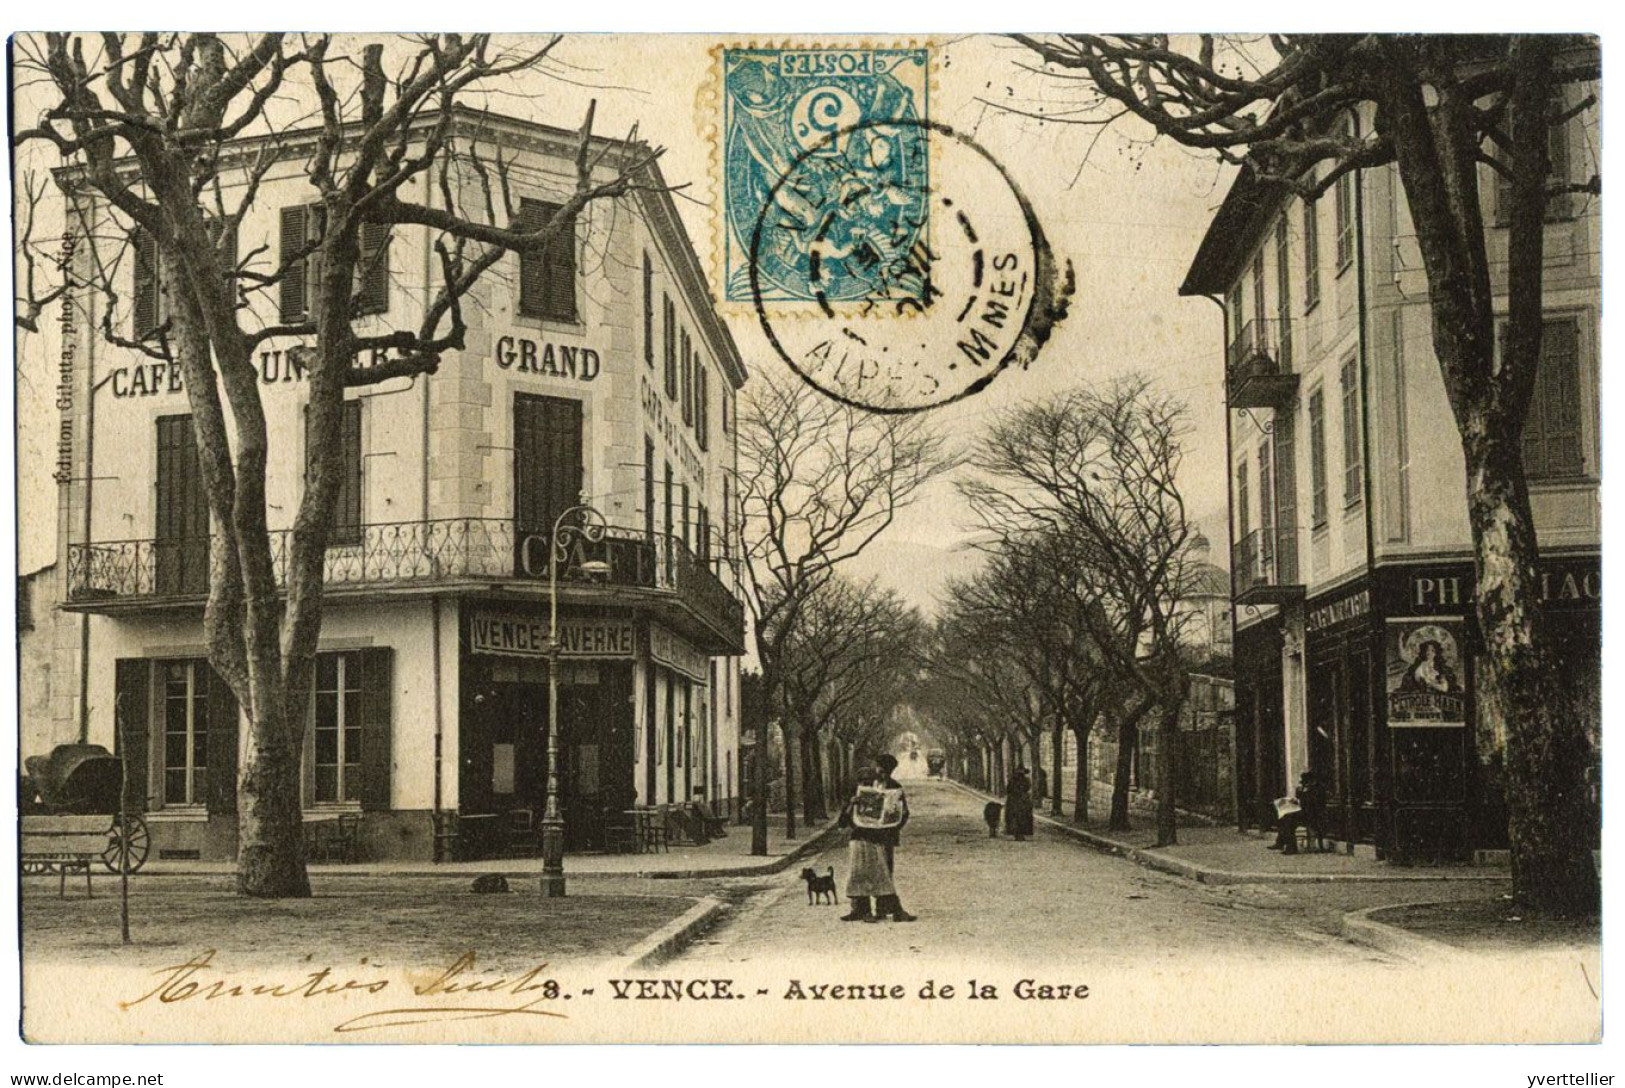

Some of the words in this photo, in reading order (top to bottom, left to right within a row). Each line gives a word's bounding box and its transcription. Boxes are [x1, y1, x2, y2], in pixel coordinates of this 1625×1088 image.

[783, 53, 875, 75] POSTES
[496, 335, 601, 382] GRAND
[476, 618, 632, 652] VENCE-AVERNE
